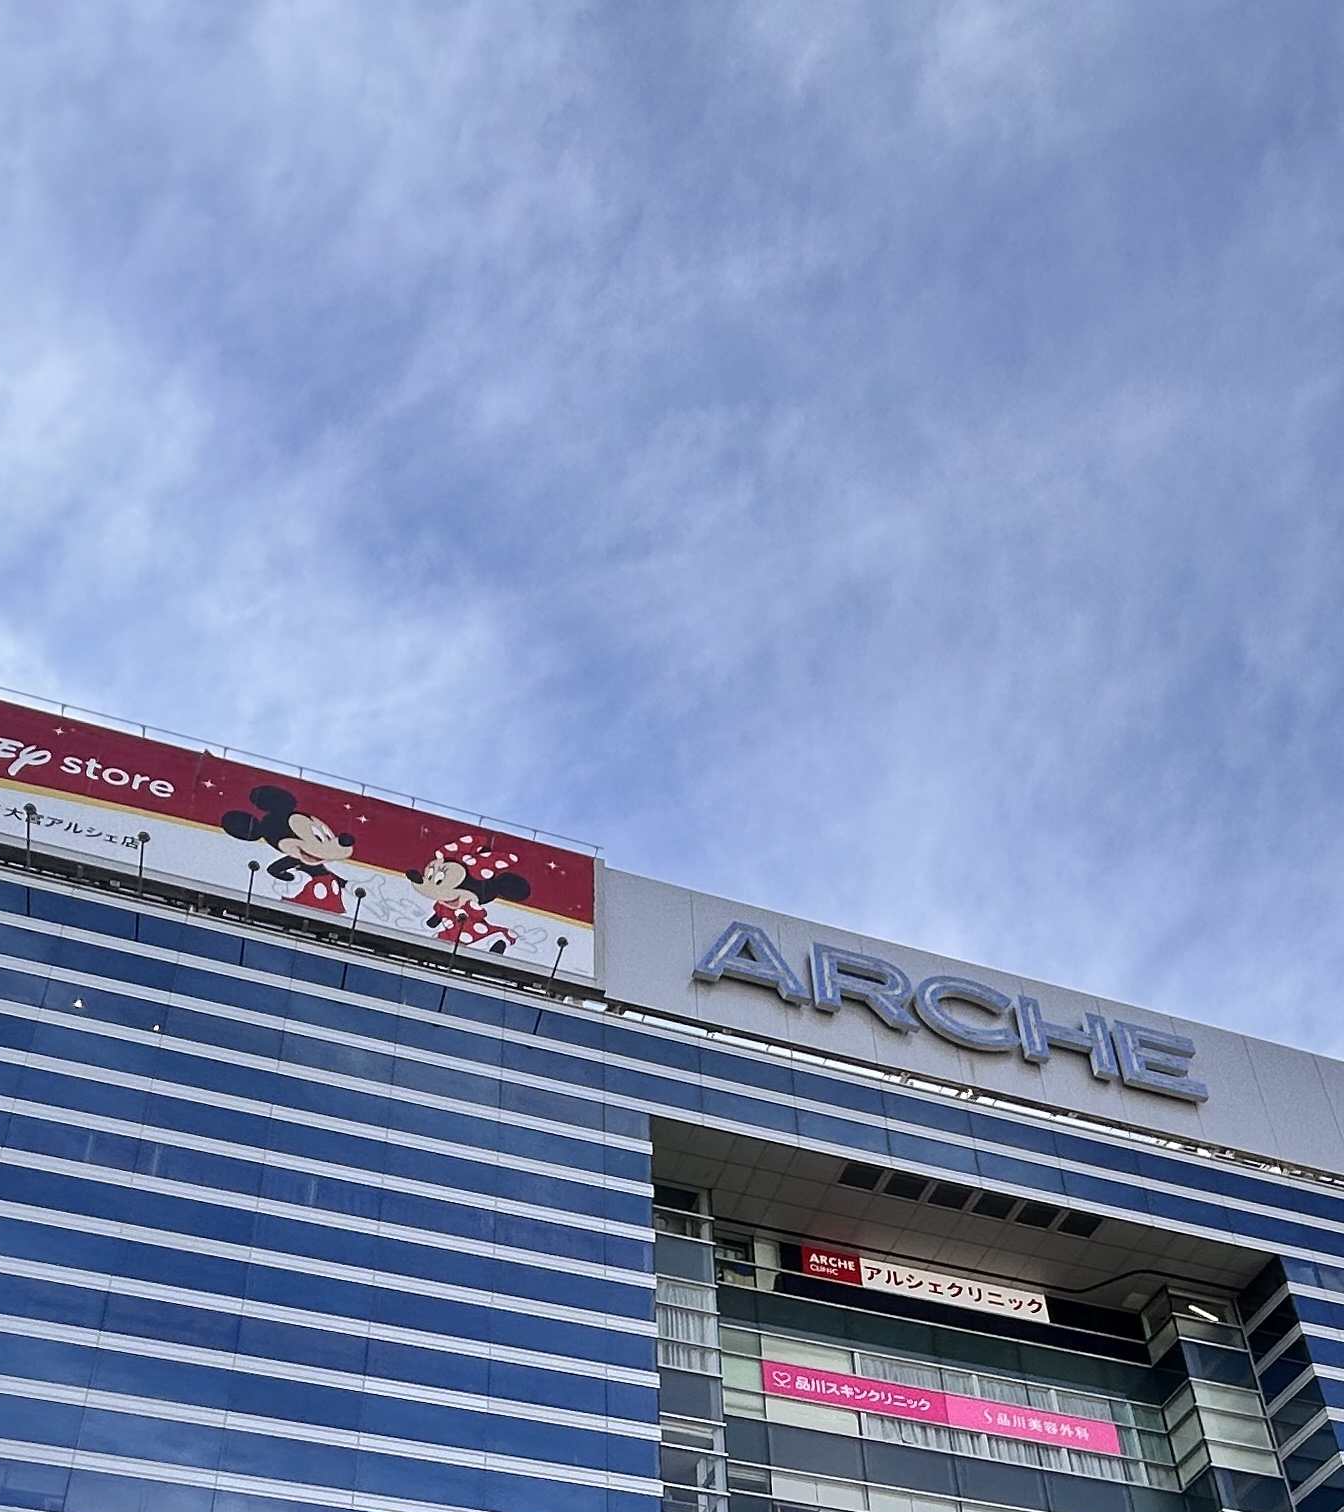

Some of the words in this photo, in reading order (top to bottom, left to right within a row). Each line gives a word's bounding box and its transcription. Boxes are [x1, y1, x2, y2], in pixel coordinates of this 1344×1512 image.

[60, 754, 176, 799] store
[692, 920, 1209, 1104] ARCHE
[809, 1252, 856, 1272] ARCHE
[863, 1265, 1044, 1315] アルシェクリニック
[794, 1376, 932, 1412] 品川スキンクリニック
[996, 1411, 1090, 1441] 品川美容外科
